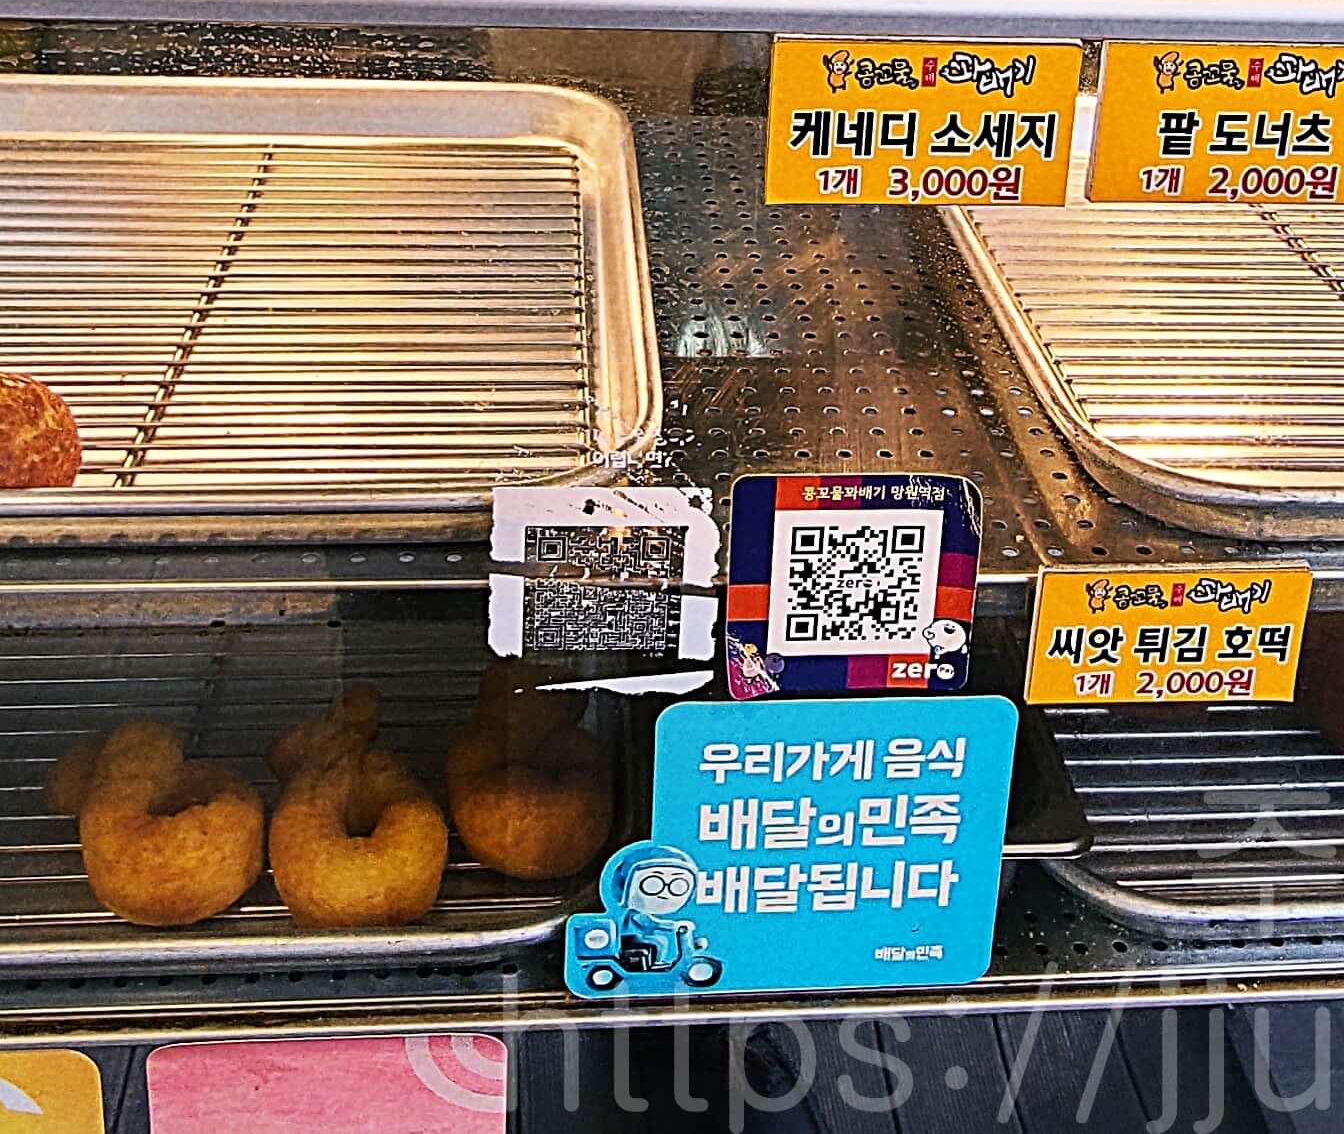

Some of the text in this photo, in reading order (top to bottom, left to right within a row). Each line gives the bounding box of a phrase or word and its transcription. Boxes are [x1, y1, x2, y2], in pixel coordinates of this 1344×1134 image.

[790, 111, 1057, 158] 케네디 소세지
[1158, 111, 1332, 158] 팥 도너츠
[817, 167, 1022, 201] 1개 3,000원
[1140, 167, 1339, 201] 1개 2,000원
[1047, 624, 1292, 664] 씨앗 튀김 호떡
[1076, 668, 1255, 699] 1개 2,000원
[699, 737, 968, 784] 우리가게 음식
[698, 794, 962, 851] 배달의민족
[695, 860, 960, 913] 배달됩니다
[874, 945, 944, 962] 배달의민족
